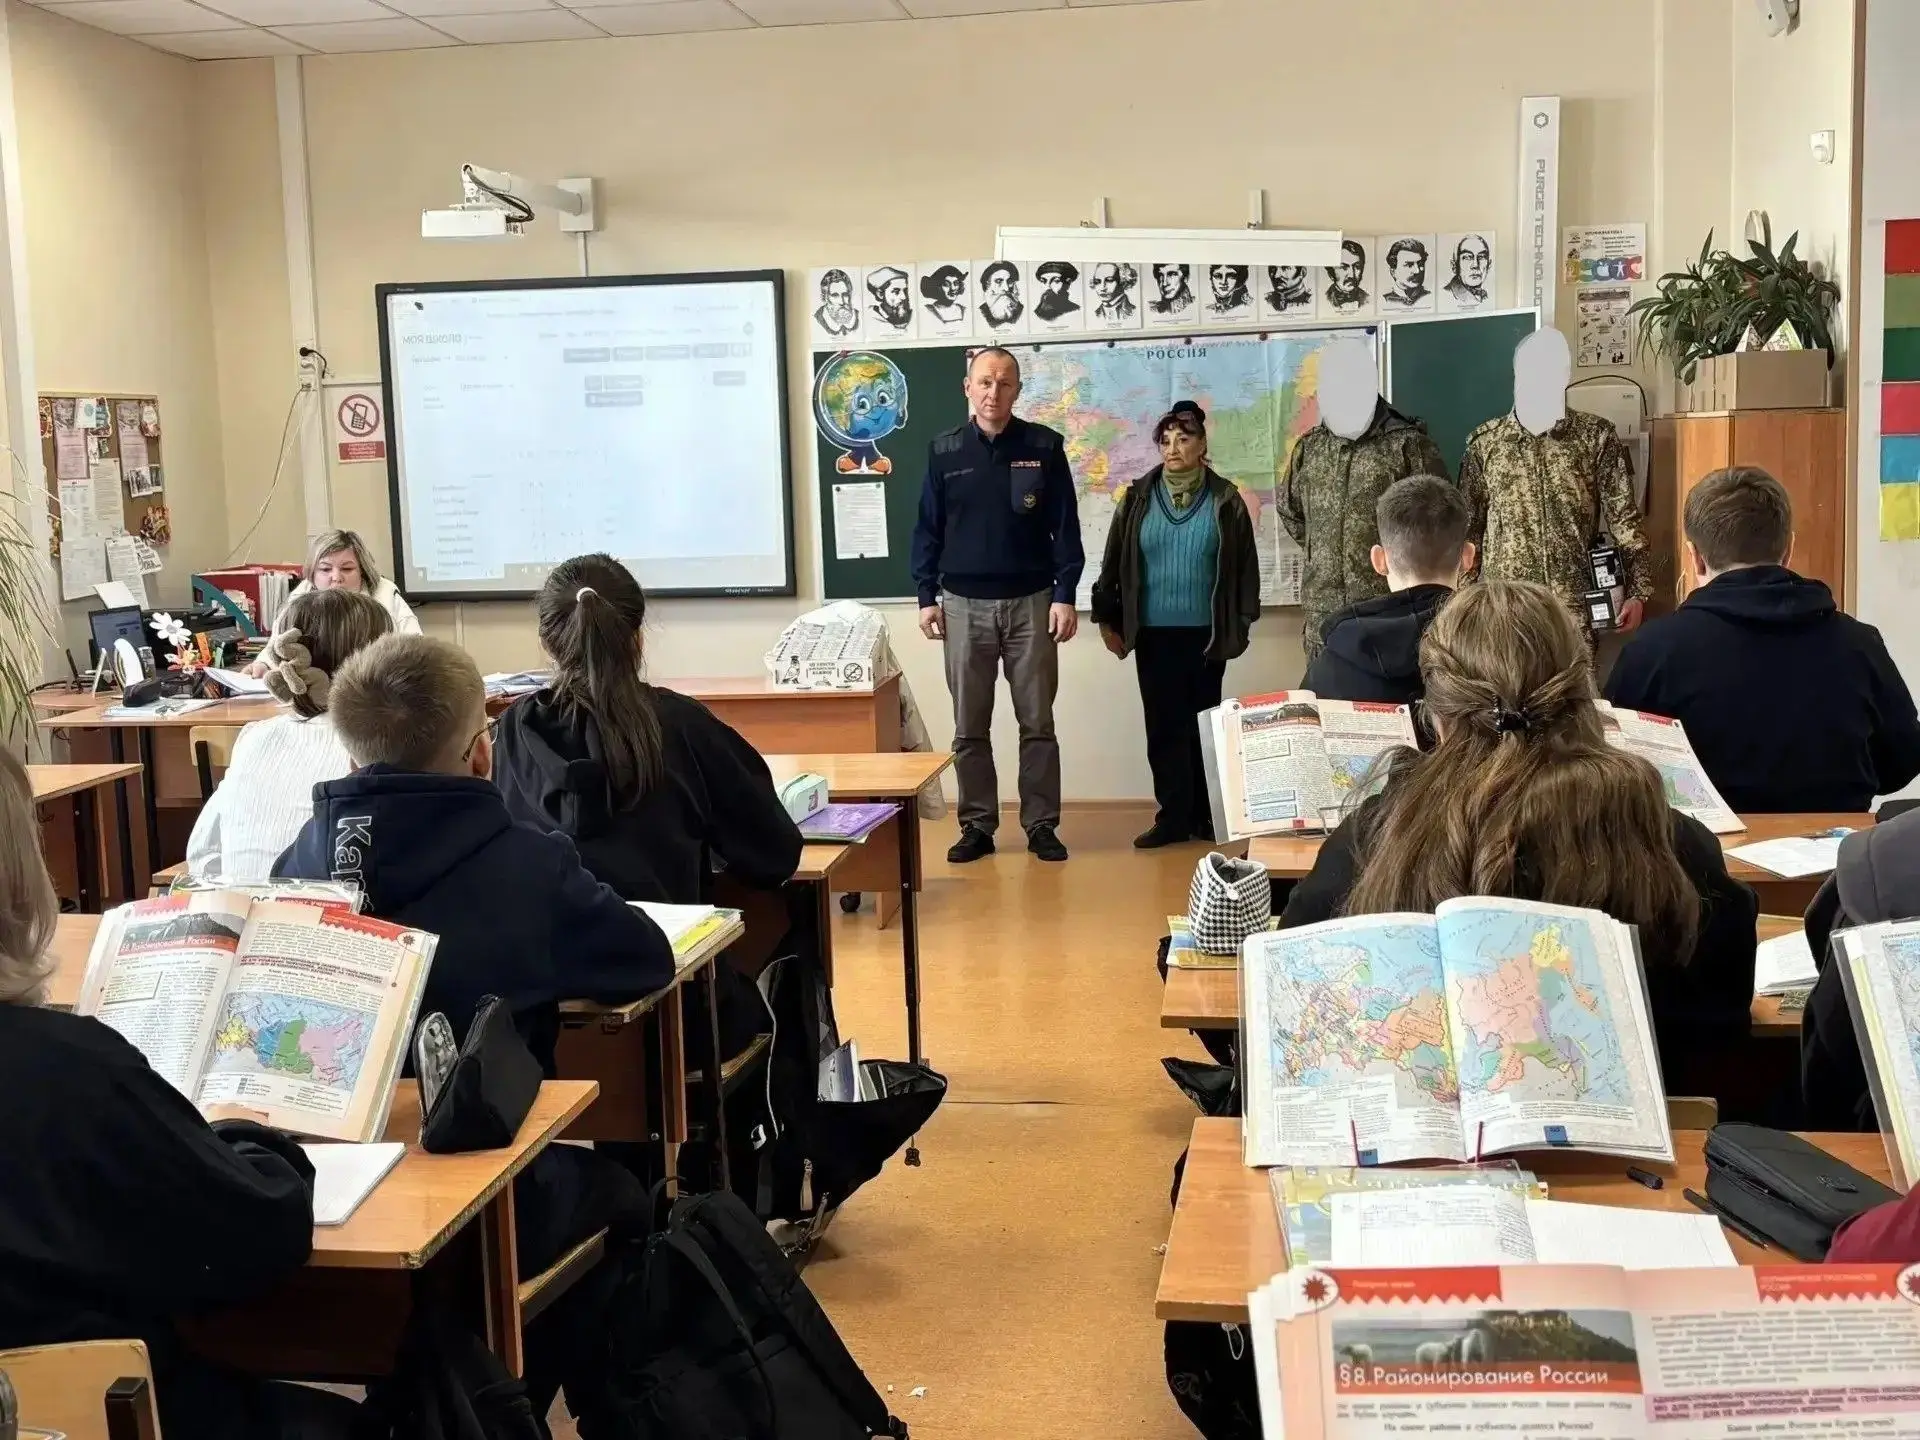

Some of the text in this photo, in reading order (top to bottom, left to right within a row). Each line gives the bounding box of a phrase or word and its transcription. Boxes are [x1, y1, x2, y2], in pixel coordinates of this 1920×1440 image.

[1146, 347, 1207, 360] РОССИЯ
[1373, 1367, 1534, 1390] Районирование
[1539, 1364, 1609, 1385] России
